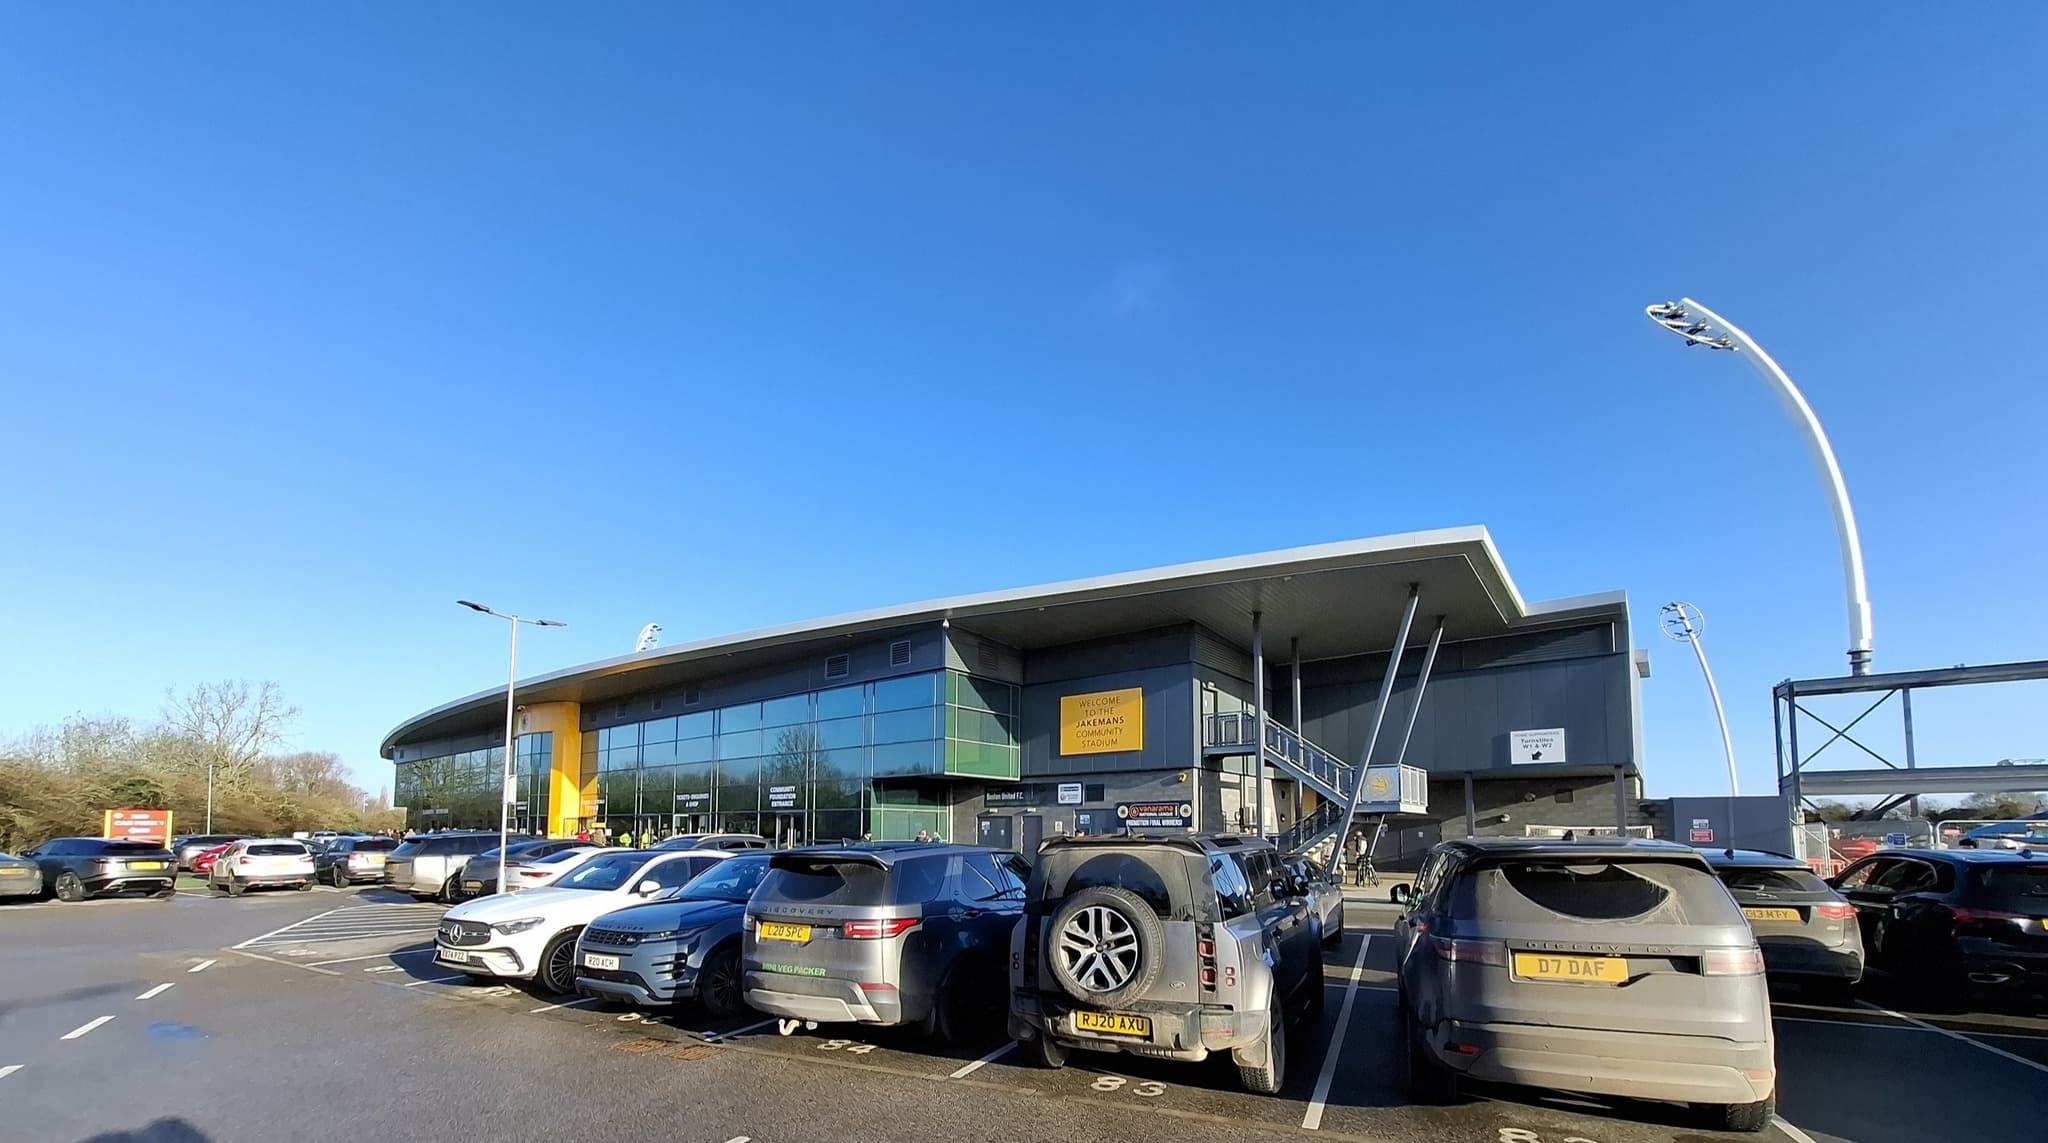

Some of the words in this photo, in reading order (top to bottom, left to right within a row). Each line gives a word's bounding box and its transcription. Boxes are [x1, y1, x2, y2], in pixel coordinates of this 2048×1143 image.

[1080, 696, 1121, 708] WELCOME
[1085, 708, 1096, 717] TO
[1100, 707, 1115, 715] THE
[1076, 716, 1125, 728] JAKEMANS
[1076, 727, 1123, 739] COMMUNITY
[1082, 738, 1118, 749] STADIUM
[763, 904, 833, 914] DISCOVERY
[768, 925, 784, 937] L20
[786, 927, 804, 938] SPC
[777, 964, 793, 974] VEG
[793, 965, 827, 977] PACKER
[1538, 958, 1561, 974] D7
[1569, 960, 1605, 977] DAF
[1082, 1013, 1115, 1029] RJ20
[1120, 1016, 1145, 1032] AXU
[816, 1039, 878, 1055] 84
[1091, 1076, 1167, 1097] 83
